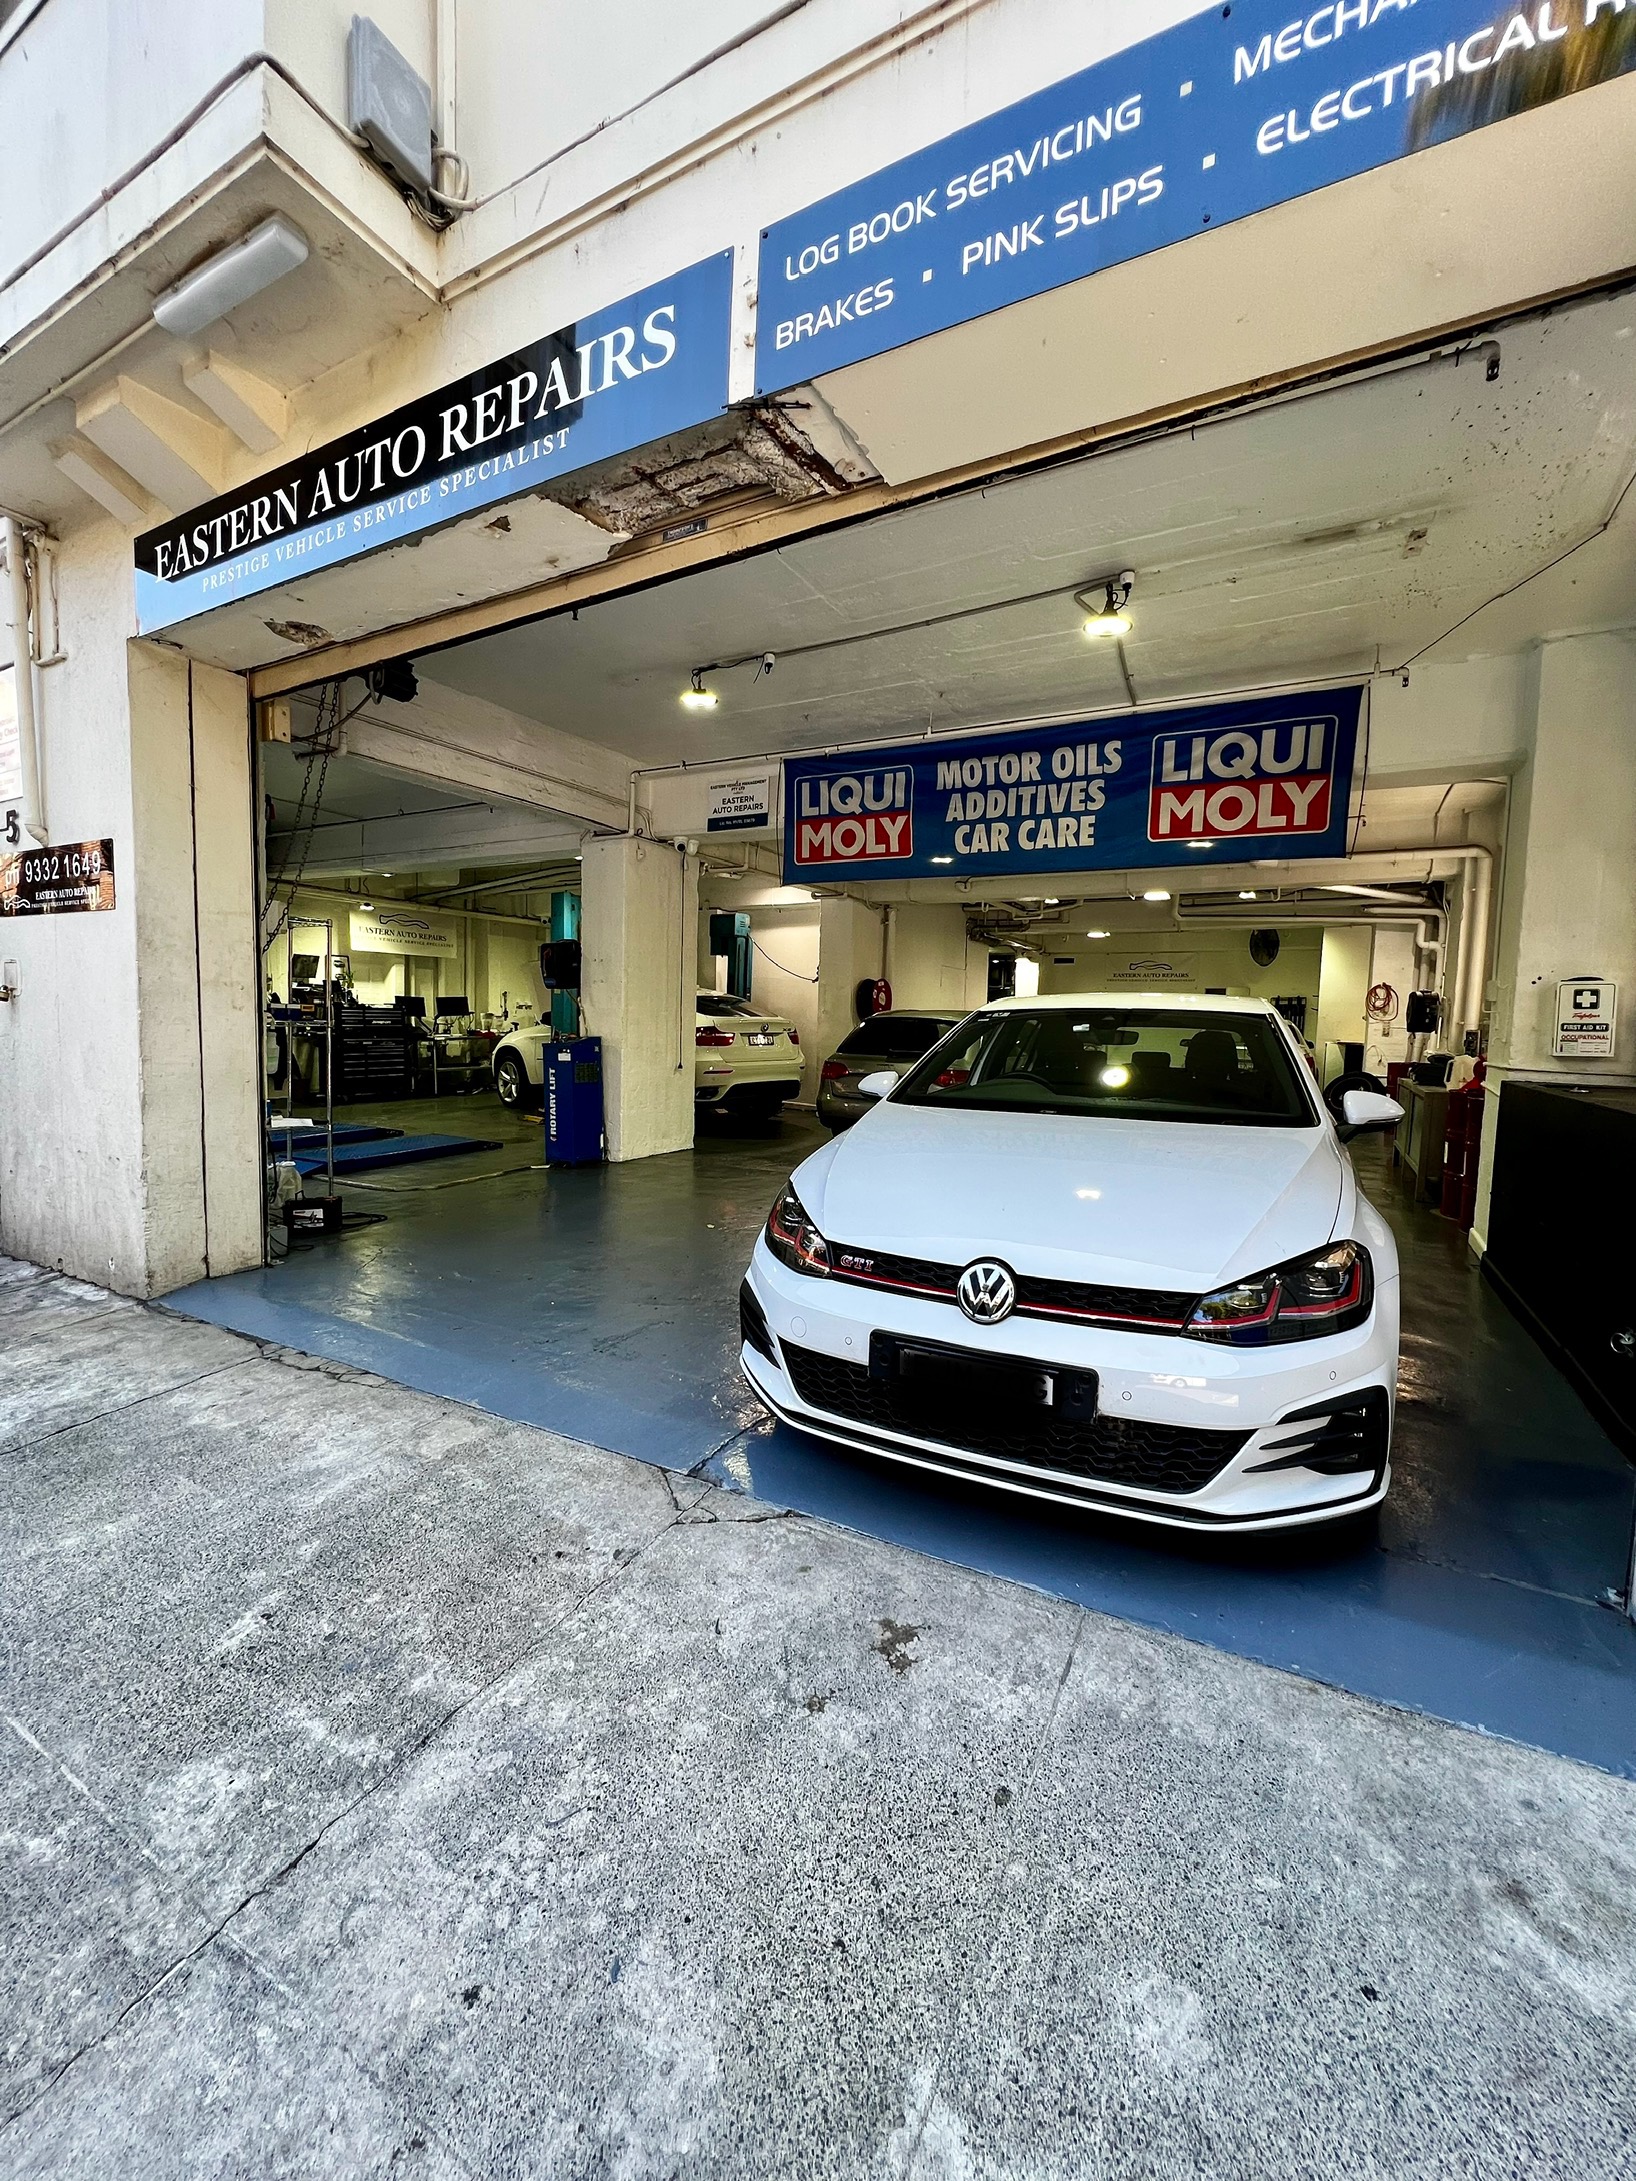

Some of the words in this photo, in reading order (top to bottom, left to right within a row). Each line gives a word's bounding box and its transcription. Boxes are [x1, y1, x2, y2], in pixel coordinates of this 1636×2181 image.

[785, 234, 840, 281] LOG
[848, 188, 937, 254] BOOK
[946, 93, 1142, 211] SERVICING
[1234, 0, 1418, 85] MECHA
[775, 277, 894, 351] BRAKES
[962, 214, 1045, 275] PINK
[1054, 165, 1164, 239] SLIPS
[1256, 2, 1568, 155] ELECTRICAL
[154, 479, 301, 583] EASTERN
[308, 425, 426, 519] AUTO
[438, 304, 676, 462] REPAIRS
[202, 553, 270, 593] PRESTIGE
[275, 522, 346, 562] VEHICLE
[353, 487, 431, 532] SERVICE
[439, 427, 571, 497] SPECIALIST
[936, 751, 1042, 790] MOTOR
[1051, 740, 1122, 779] OILS
[1161, 724, 1325, 782] LIQUI
[712, 806, 732, 815] AUTO
[734, 803, 764, 812] REPAIRS
[722, 795, 754, 805] EASTERN
[801, 772, 906, 817] LIQUI
[945, 779, 1106, 822] ADDITIVES
[1159, 780, 1326, 834] MOLY
[801, 815, 908, 859] MOLY
[954, 822, 1010, 854] CAR
[1017, 815, 1096, 850] CARE
[25, 857, 60, 883] 9332
[63, 850, 101, 878] 1649
[35, 889, 58, 900] EASTERN
[59, 888, 73, 898] AUTO
[359, 926, 395, 937] ASTERN
[397, 931, 417, 939] AUTO
[418, 933, 447, 942] REPAIRS
[549, 1092, 557, 1135] ROTARY
[840, 1254, 875, 1272] GTI
